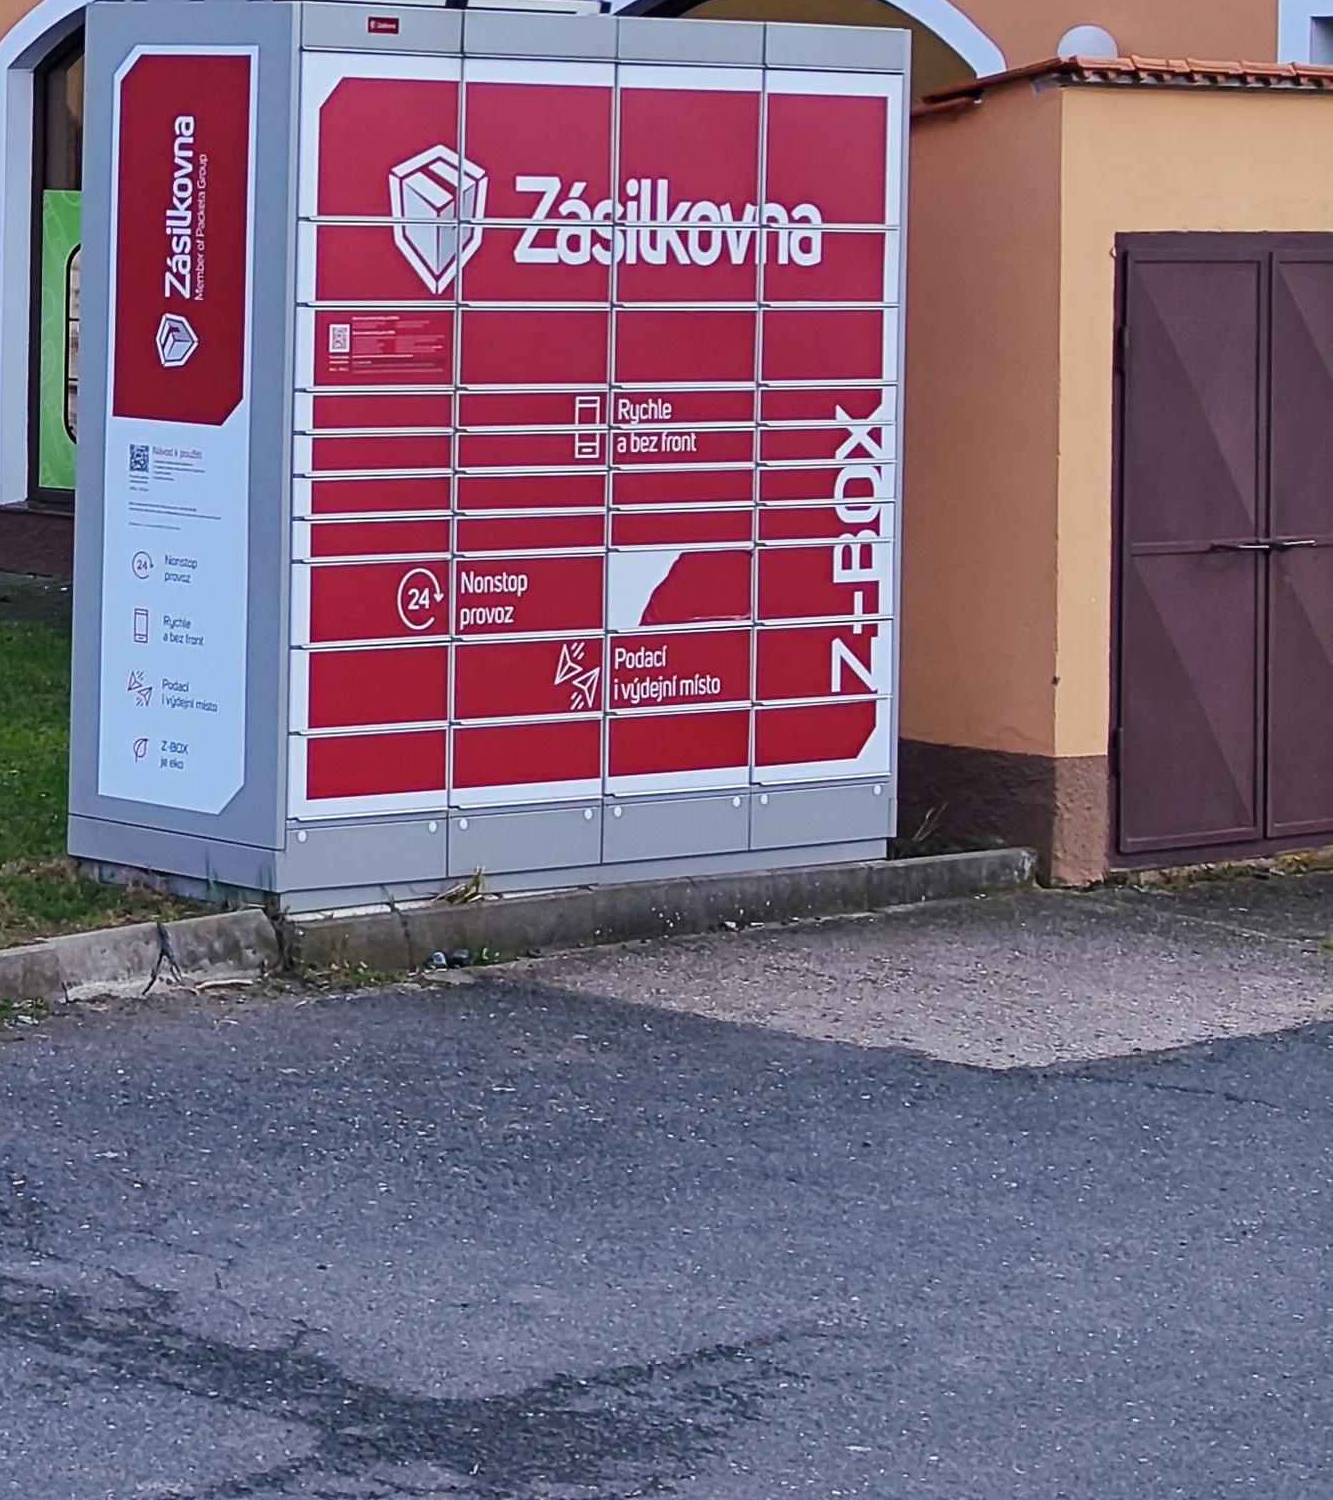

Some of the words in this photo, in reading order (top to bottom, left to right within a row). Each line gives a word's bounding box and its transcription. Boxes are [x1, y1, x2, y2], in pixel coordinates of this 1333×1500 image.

[196, 154, 209, 189] Group
[164, 115, 195, 299] Zásilkovna
[195, 191, 206, 237] Packeta
[513, 175, 822, 266] Zásilkovna
[196, 239, 205, 250] of
[194, 254, 205, 301] Member
[617, 398, 672, 424] Rychle
[617, 436, 627, 453] a
[630, 431, 658, 453] bez
[661, 431, 697, 452] front
[831, 404, 883, 693] Z-BOX
[137, 560, 148, 570] 24
[164, 554, 198, 569] Nonstop
[164, 572, 191, 583] provoz
[461, 571, 528, 597] Nonstop
[408, 587, 430, 610] 24
[163, 615, 191, 629] Rychle
[460, 606, 514, 630] provoz
[163, 633, 168, 641] a
[170, 632, 184, 644] bez
[185, 634, 204, 646] front
[614, 645, 668, 669] Podací
[162, 678, 190, 692] Podací
[614, 679, 618, 700] i
[621, 675, 677, 704] výdejní
[679, 674, 721, 696] místo
[166, 696, 195, 710] výdejní
[195, 700, 218, 712] místo
[161, 740, 189, 755] Z-BOX
[160, 756, 168, 768] je
[169, 758, 184, 769] eko
